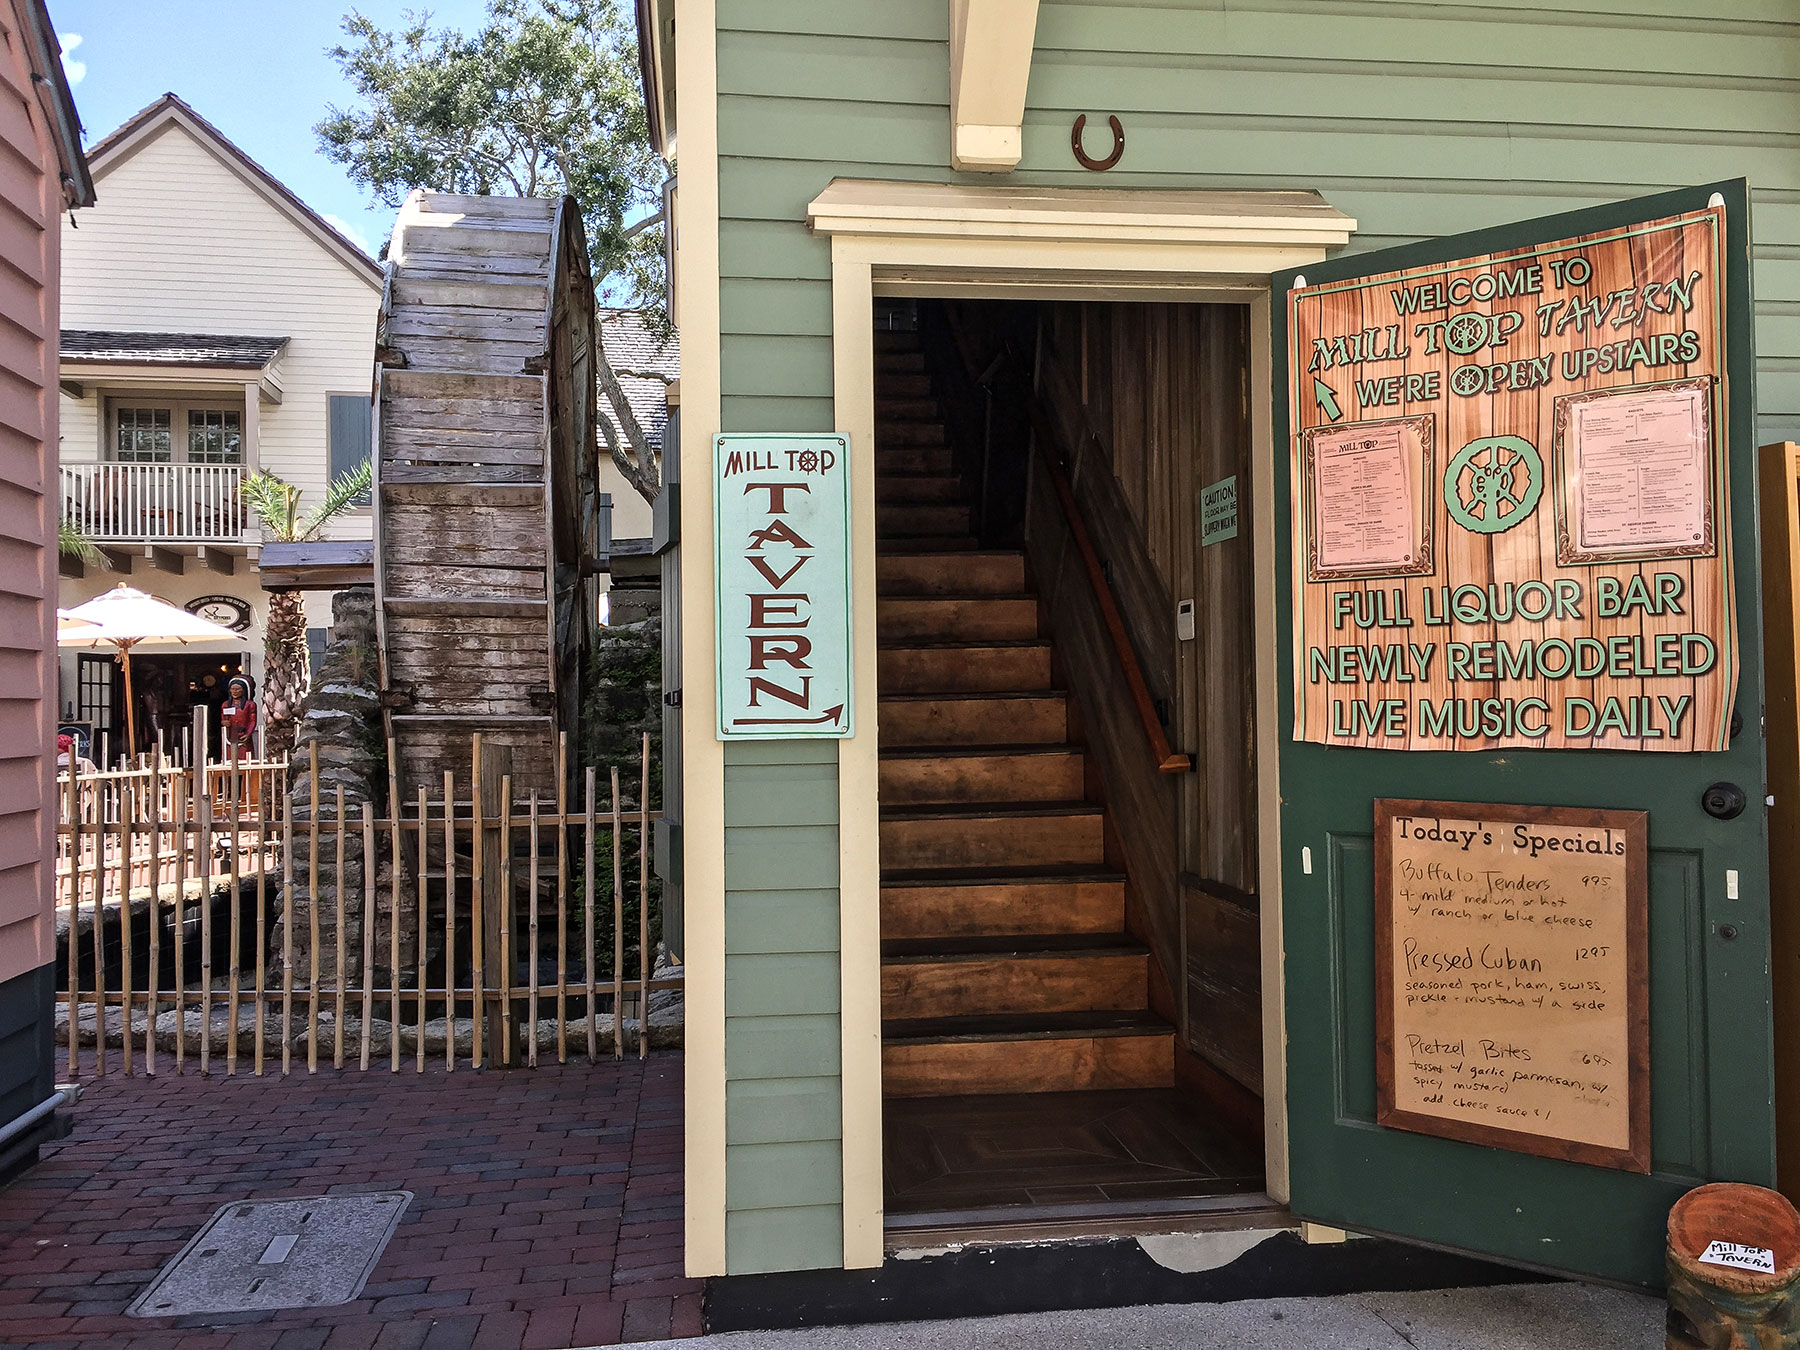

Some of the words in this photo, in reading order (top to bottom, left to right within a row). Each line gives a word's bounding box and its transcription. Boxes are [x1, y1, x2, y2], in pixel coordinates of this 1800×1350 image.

[1391, 265, 1542, 314] WELCOME
[1549, 256, 1591, 289] TO
[1308, 326, 1409, 372] MILL
[1416, 311, 1522, 355] TOP
[1536, 271, 1701, 336] TAVERN
[1355, 371, 1440, 408] WE'RE
[1450, 353, 1555, 397] OPEN
[1561, 330, 1700, 381] UPSTAIRS
[723, 450, 779, 478] MILL
[784, 448, 835, 476] TOP
[1204, 484, 1234, 507] CAUTION
[1204, 507, 1220, 519] FLOOR
[743, 482, 815, 711] TAVERN
[1333, 588, 1412, 629] FULL
[1424, 579, 1582, 625] LIQUOR
[1598, 572, 1683, 618] BAR
[1310, 643, 1436, 684] NEWLY
[1447, 634, 1716, 682] REMODELED
[1333, 699, 1407, 738] LIVE
[1419, 697, 1550, 738] MUSIC
[1565, 696, 1692, 739] DAILY
[1396, 817, 1493, 851] Today's
[1513, 825, 1626, 858] Specials
[1399, 858, 1473, 883] Buffalo
[1478, 870, 1551, 893] Tenders
[1464, 894, 1515, 906] medium
[1523, 898, 1535, 906] or
[1540, 893, 1567, 907] hot
[1431, 907, 1472, 919] ranch
[1482, 912, 1494, 921] or
[1504, 909, 1535, 923] blue
[1544, 915, 1593, 930] cheese
[1403, 937, 1473, 977] Pressed
[1481, 943, 1543, 973] Cuban
[1405, 978, 1464, 991] seasoned
[1470, 979, 1510, 993] pork,
[1515, 977, 1553, 993] ham,
[1559, 981, 1607, 994] swiss,
[1405, 993, 1447, 1006] pickle
[1551, 1000, 1562, 1008] a
[1572, 999, 1606, 1011] side
[1404, 1034, 1466, 1057] Pretzel
[1479, 1039, 1532, 1061] Bites
[1413, 1076, 1443, 1090] spicy
[1470, 1066, 1505, 1079] garlic
[1423, 1095, 1443, 1104] add
[1452, 1099, 1489, 1111] cheese
[1496, 1105, 1528, 1117] sauce
[1711, 1242, 1737, 1253] Mill
[1717, 1252, 1772, 1269] TAVERN
